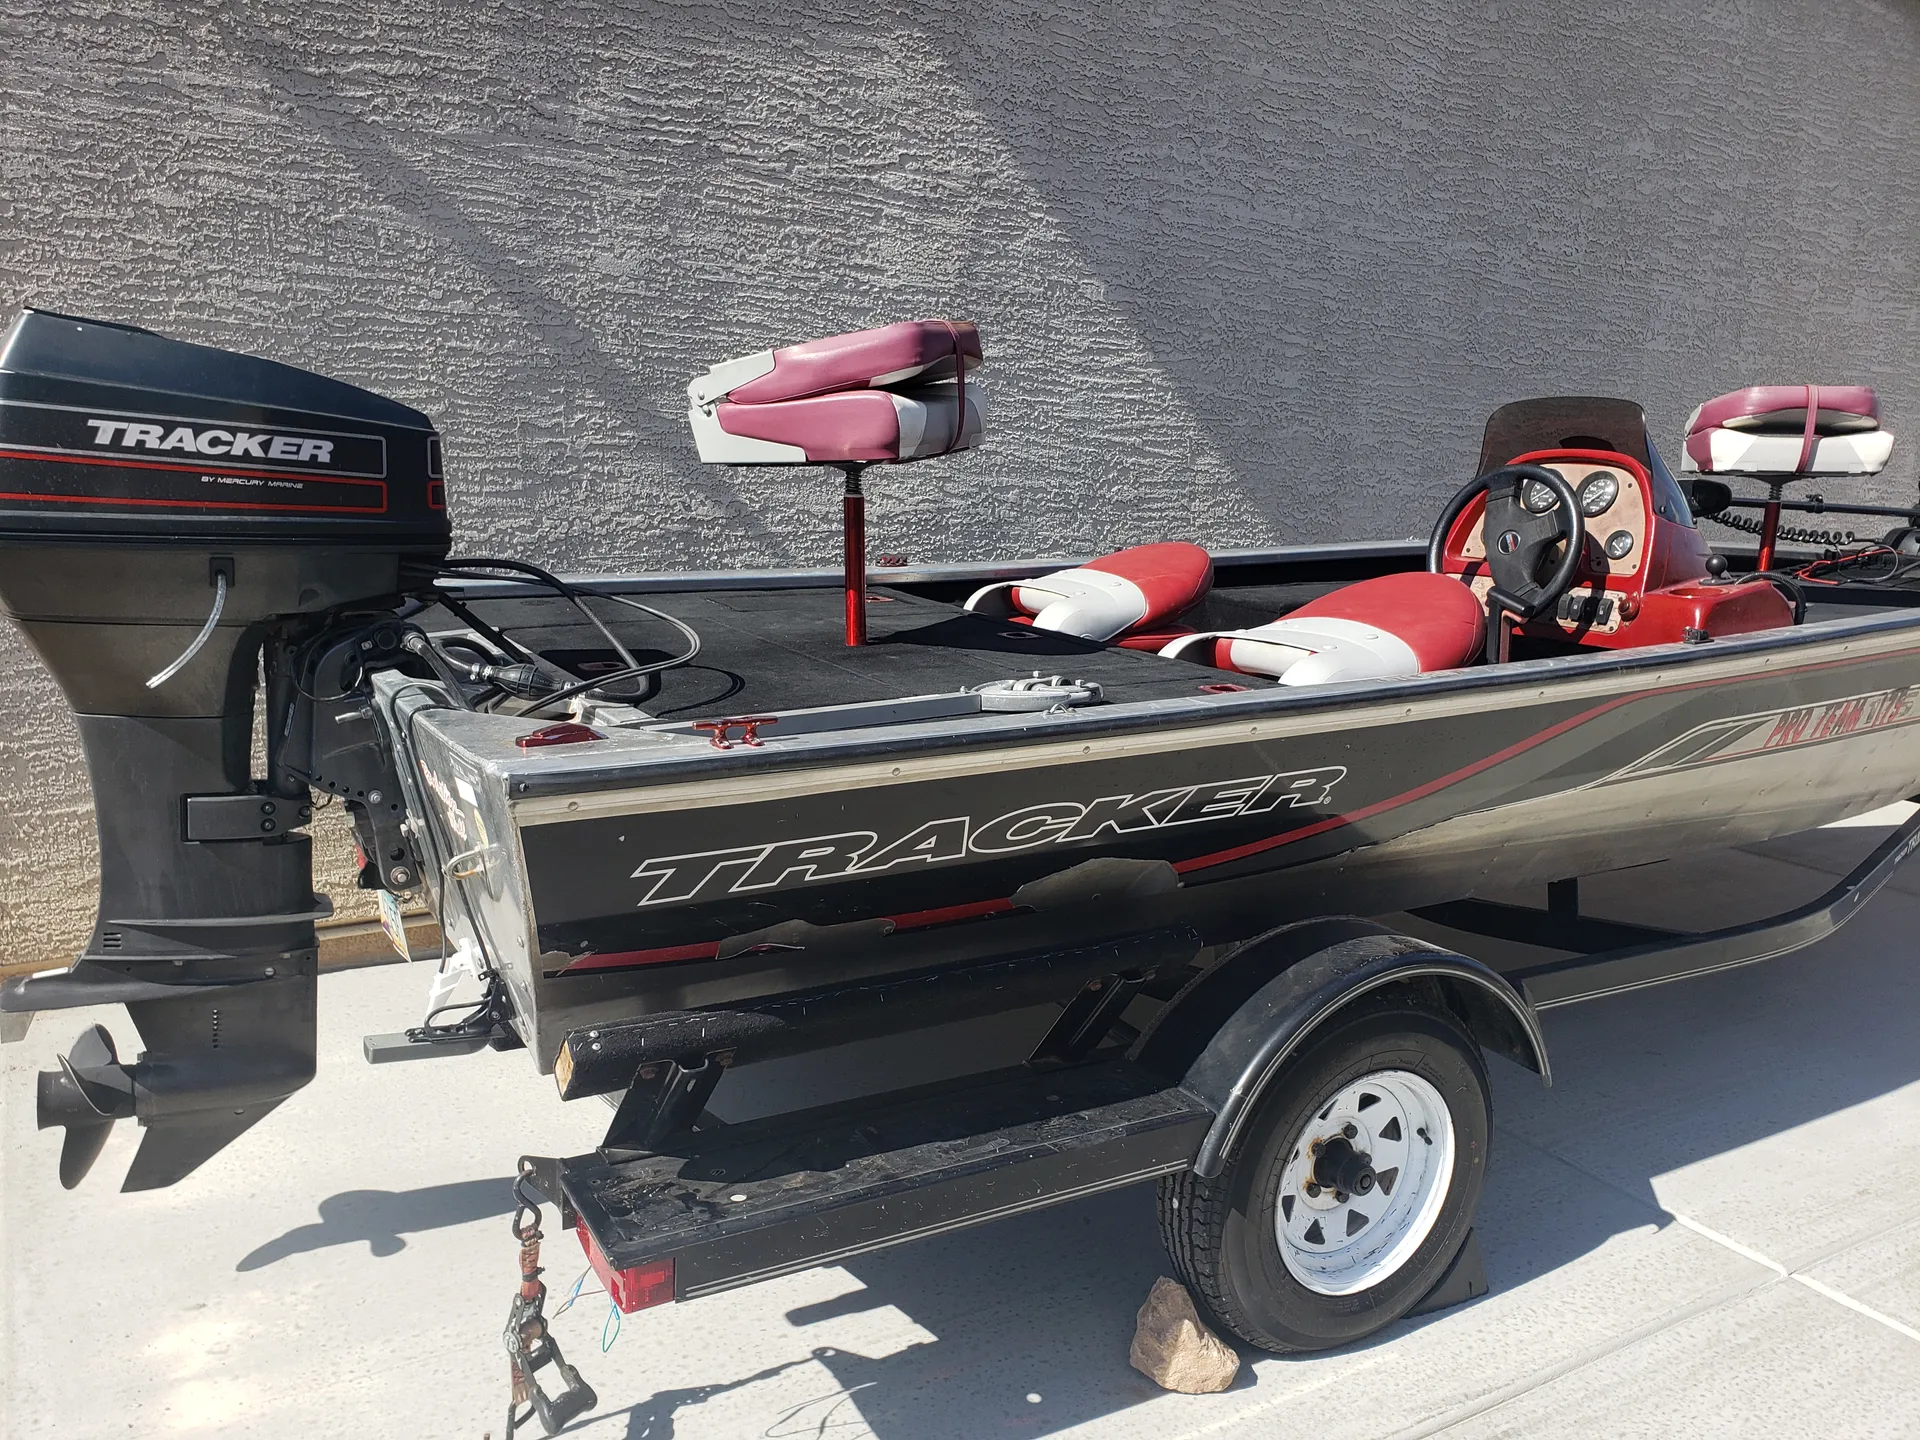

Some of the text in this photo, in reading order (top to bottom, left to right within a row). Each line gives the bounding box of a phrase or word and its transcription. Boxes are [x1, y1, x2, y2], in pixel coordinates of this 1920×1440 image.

[87, 419, 334, 463] TRACKER
[217, 477, 265, 486] MERCURY
[267, 480, 304, 489] MARINE
[1764, 706, 1815, 748] PRO
[1810, 697, 1867, 738] TEAM
[629, 765, 1347, 907] TRACKER
